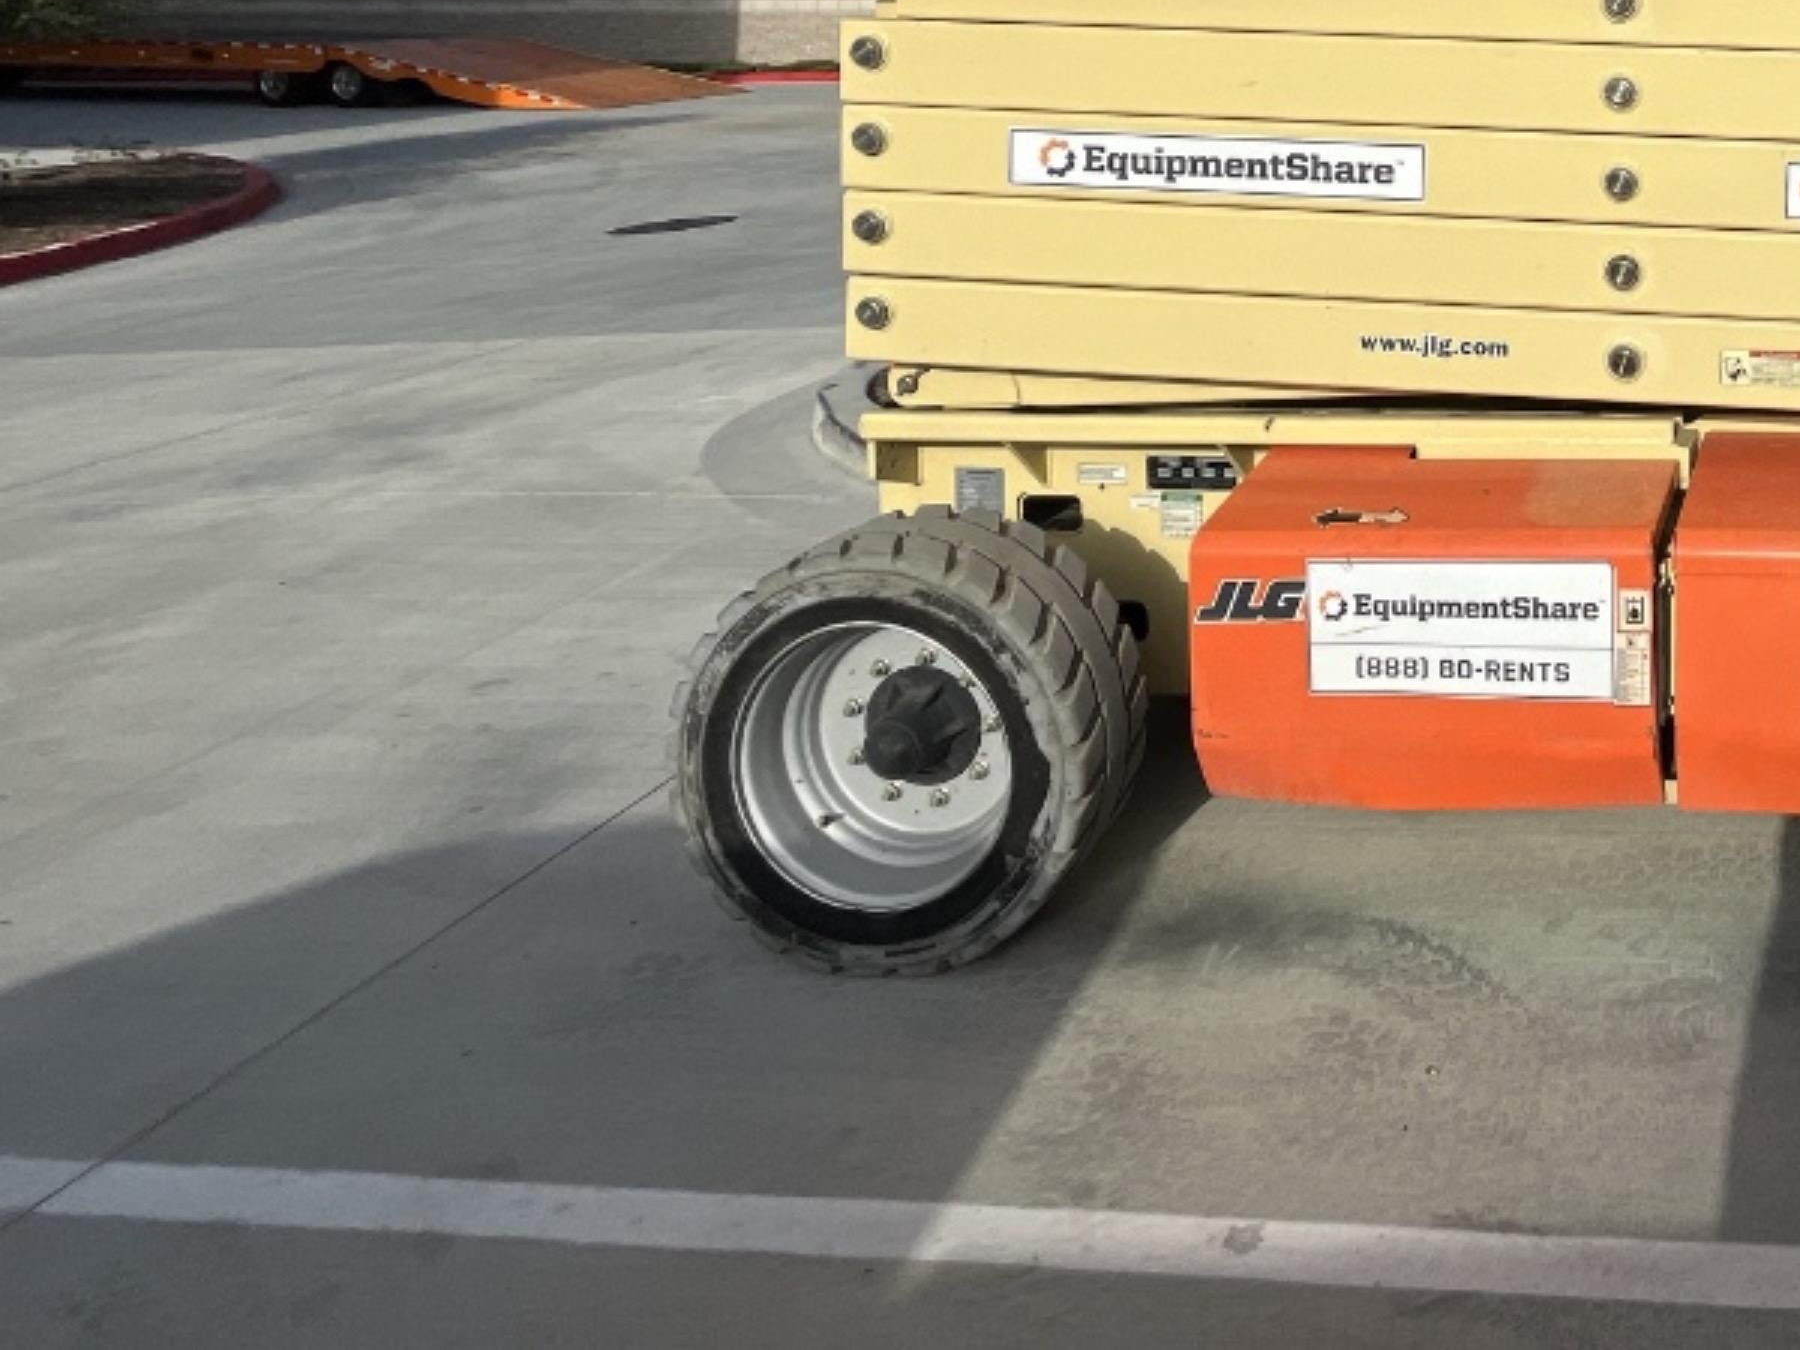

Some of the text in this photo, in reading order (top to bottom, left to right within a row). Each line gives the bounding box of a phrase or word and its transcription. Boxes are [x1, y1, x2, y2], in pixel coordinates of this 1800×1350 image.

[1082, 143, 1396, 185] EquipmentShare
[1360, 334, 1510, 358] www.jlg.com
[1195, 579, 1307, 624] JLG
[1353, 593, 1601, 622] EquipmentShare
[1355, 657, 1571, 683] (888) 80-RENTS
